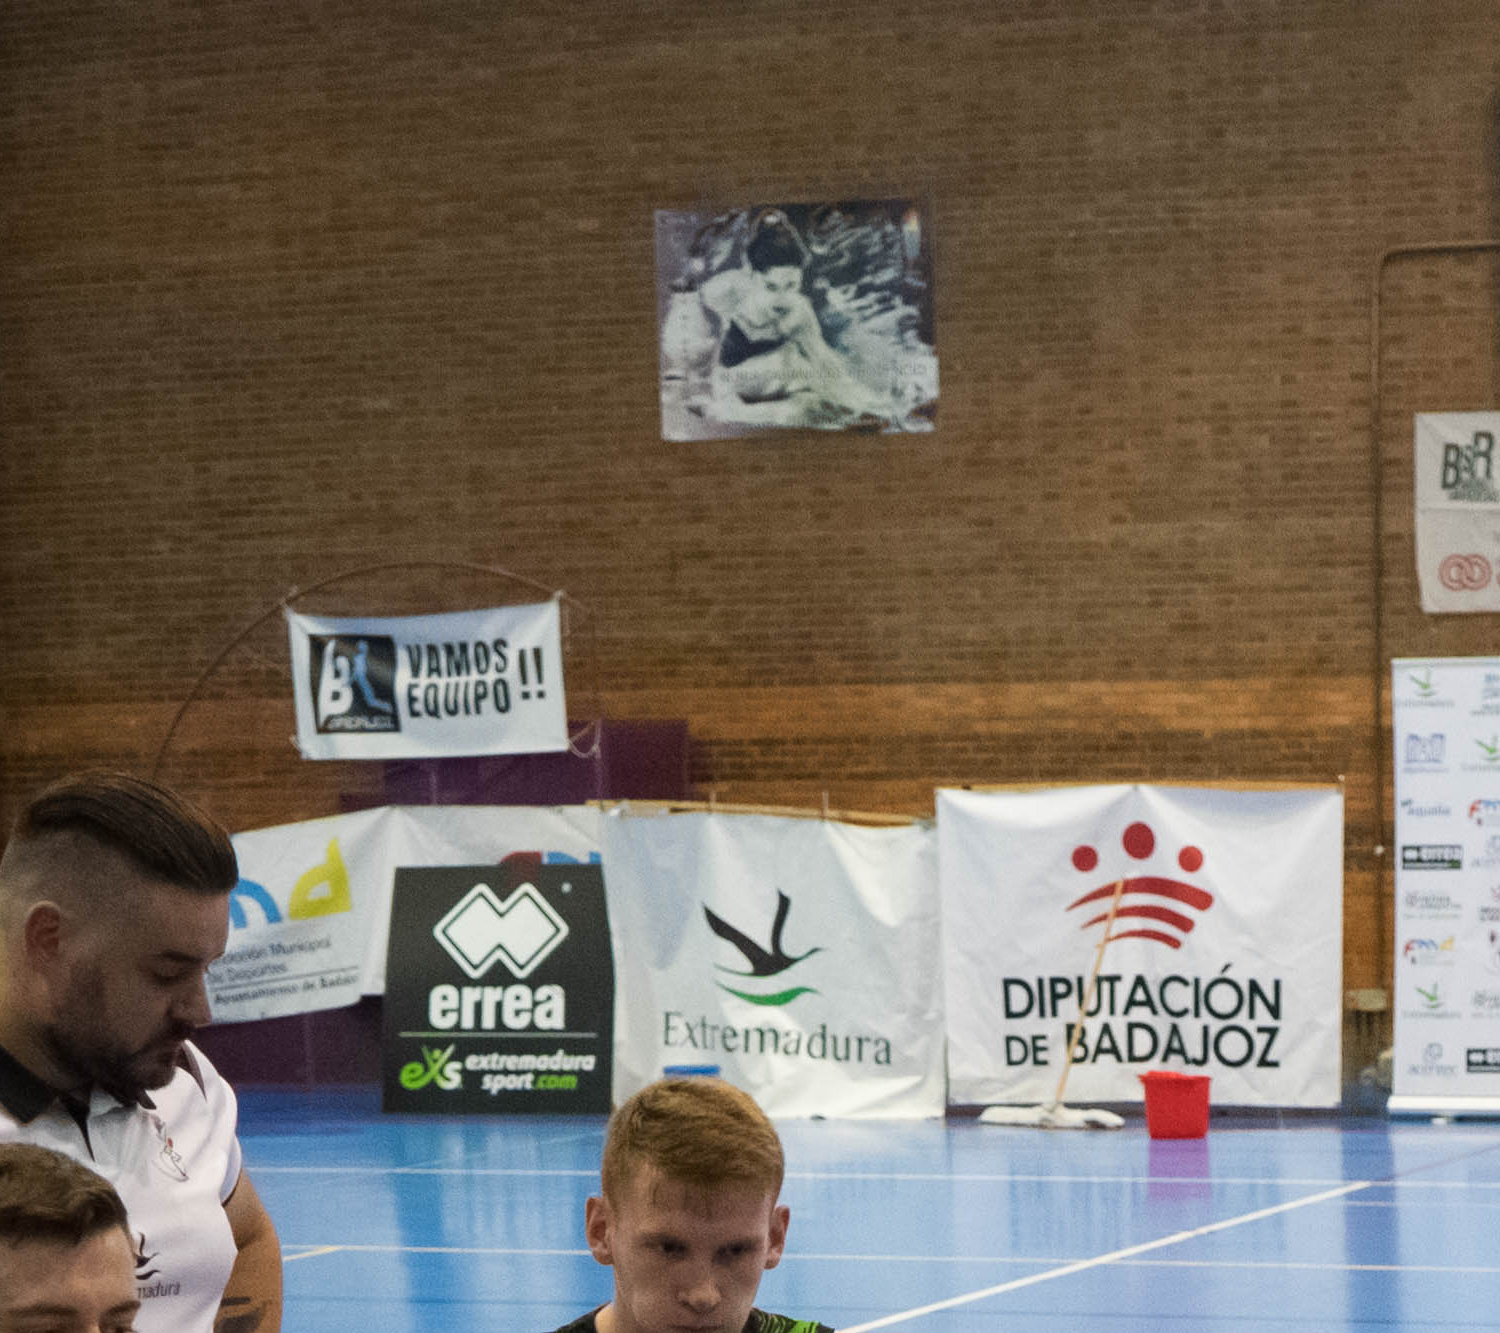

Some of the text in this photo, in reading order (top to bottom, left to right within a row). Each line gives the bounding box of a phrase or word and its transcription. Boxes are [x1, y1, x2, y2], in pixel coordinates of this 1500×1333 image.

[405, 638, 509, 680] VAMOS
[406, 678, 511, 720] EQUIPO
[428, 983, 567, 1032] errea
[1001, 962, 1283, 1022] DIPUTACIÓN
[465, 1049, 597, 1072] extremadura
[661, 1009, 894, 1067] Extremadura
[1005, 1021, 1281, 1070] DE BADAJOZ
[480, 1070, 579, 1095] sport.com
